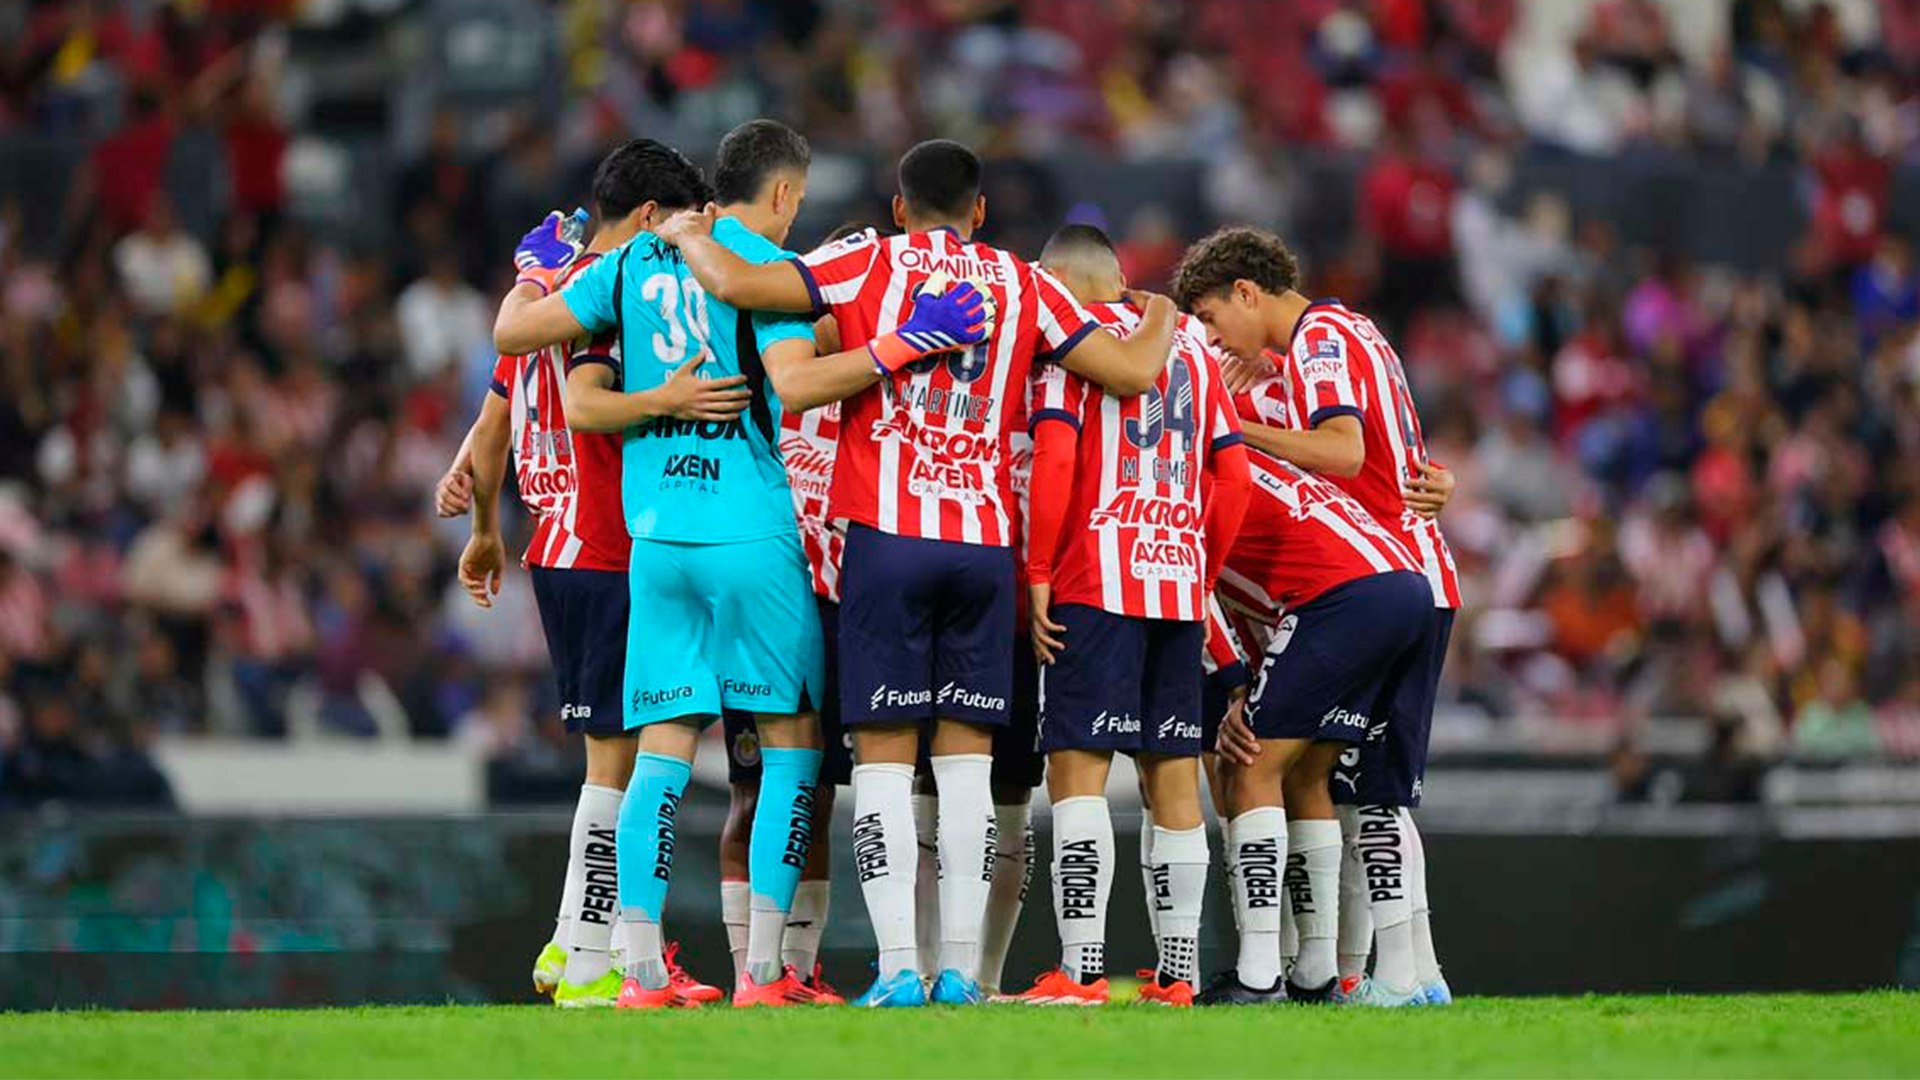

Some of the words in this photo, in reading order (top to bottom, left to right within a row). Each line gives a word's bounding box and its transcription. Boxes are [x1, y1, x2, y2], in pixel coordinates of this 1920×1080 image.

[661, 454, 720, 481] AXEN
[1135, 542, 1193, 567] AXEN
[642, 684, 694, 707] Futura
[723, 678, 772, 697] Futura
[886, 689, 933, 707] Futura
[952, 688, 1006, 711] Futura
[654, 790, 682, 881] PERDURA
[782, 783, 818, 869] PERDURA
[853, 812, 890, 883] PERDURA
[1358, 804, 1404, 903] PERDURA
[1060, 839, 1101, 920] PERDURA
